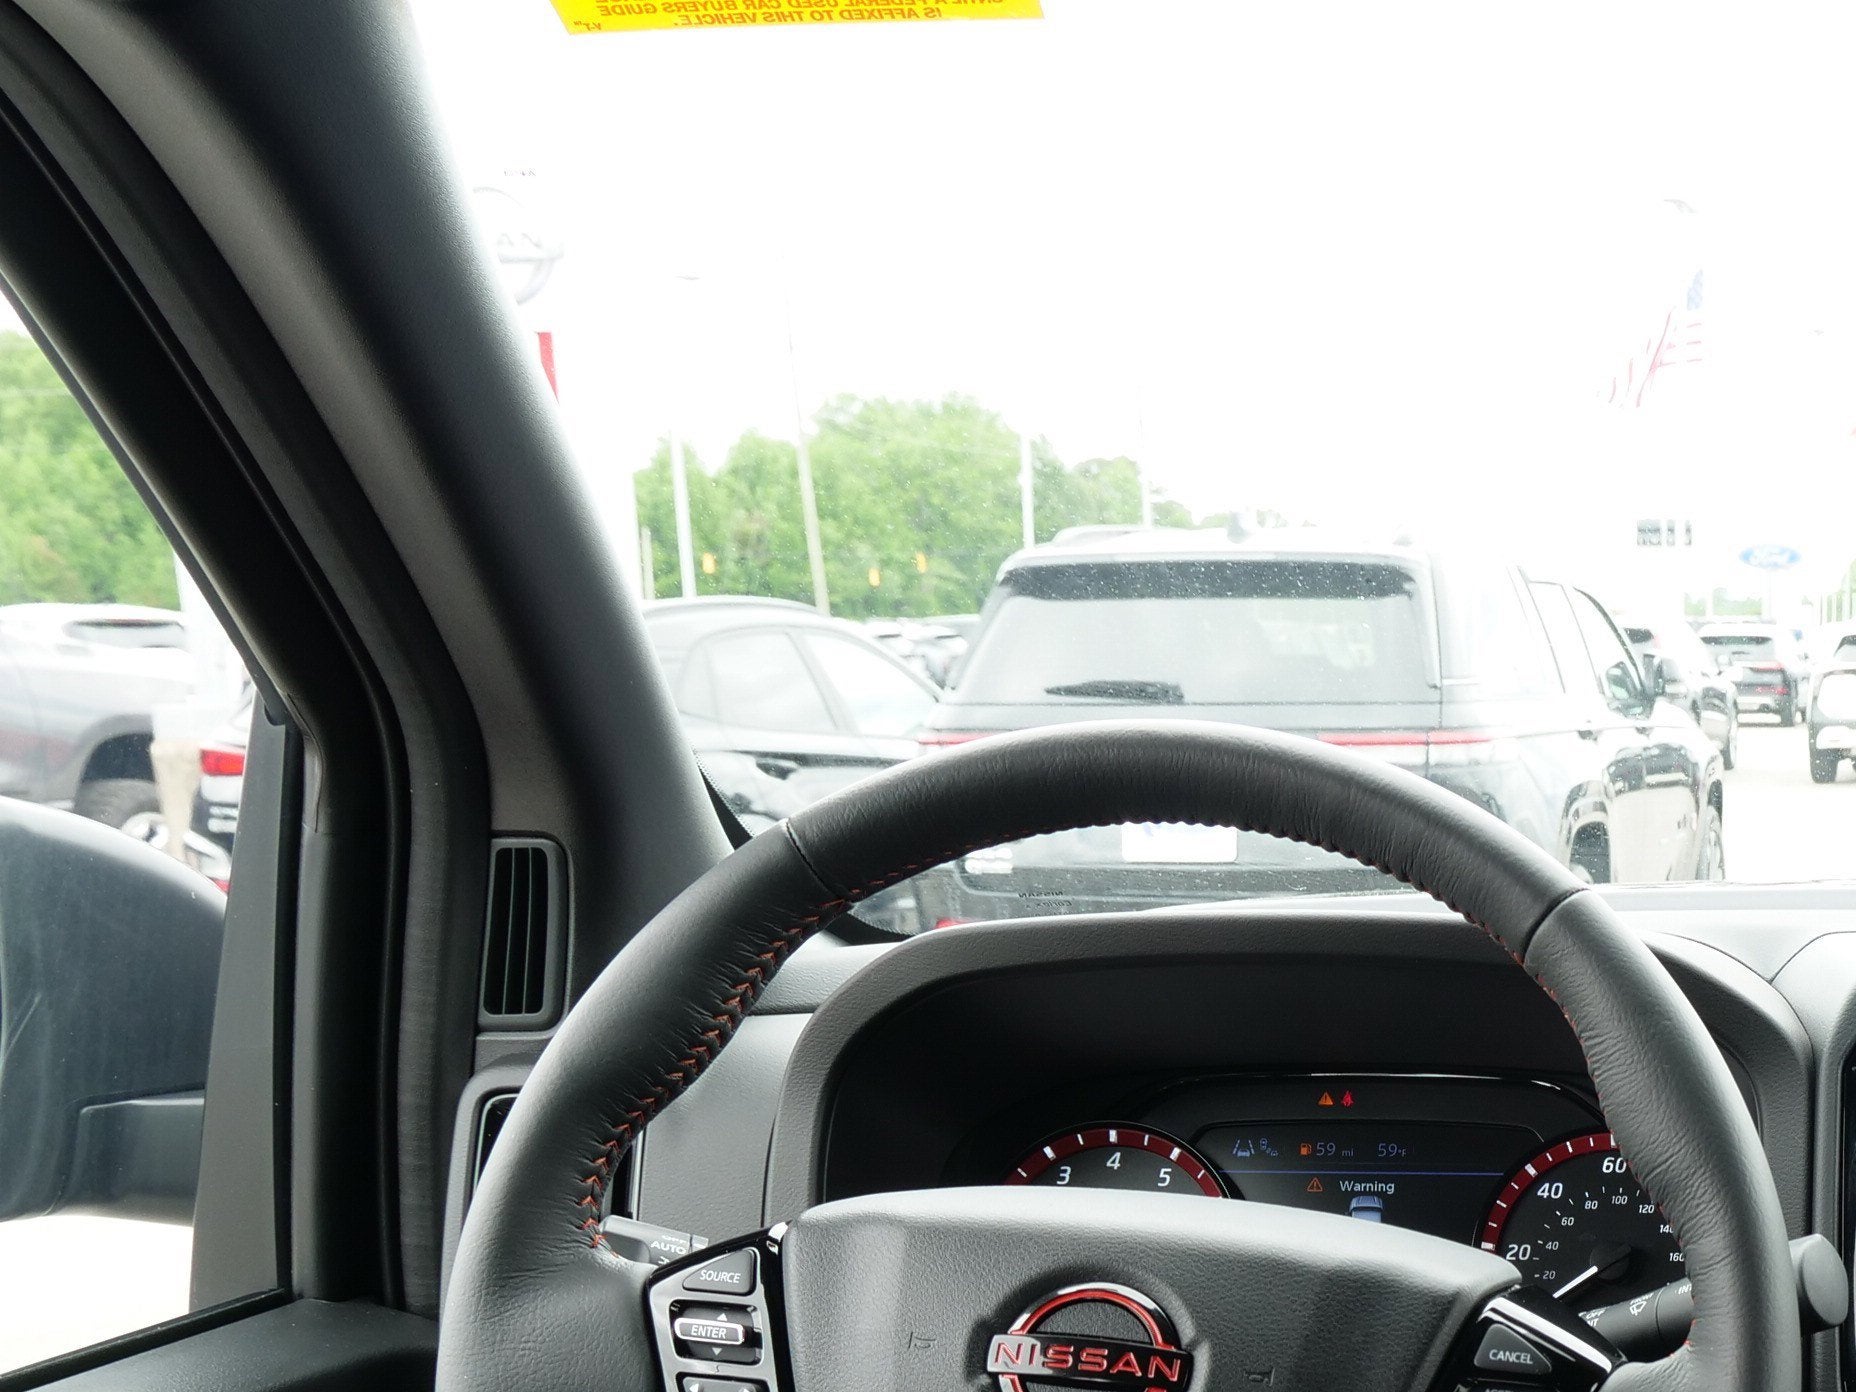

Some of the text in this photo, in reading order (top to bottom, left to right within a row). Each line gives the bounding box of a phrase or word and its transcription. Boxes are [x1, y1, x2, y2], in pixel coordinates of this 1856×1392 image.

[1316, 1142, 1354, 1157] 59 mi
[1106, 1152, 1121, 1170] 4
[1602, 1157, 1627, 1174] 60
[1057, 1166, 1071, 1185] 3
[1157, 1168, 1172, 1187] 5
[1340, 1180, 1395, 1195] Warning
[1537, 1183, 1563, 1199] 40
[1585, 1200, 1598, 1210] 80
[1611, 1195, 1628, 1205] 100
[1639, 1205, 1654, 1214] 120
[1561, 1217, 1574, 1226] 60
[650, 1240, 687, 1255] AUTO
[1506, 1244, 1531, 1261] 20
[1546, 1241, 1559, 1251] 40
[699, 1268, 741, 1284] SOURCE
[1543, 1271, 1556, 1280] 20
[691, 1324, 727, 1339] ENTER
[994, 1342, 1181, 1382] NISSAN
[1489, 1349, 1534, 1365] CANCEL
